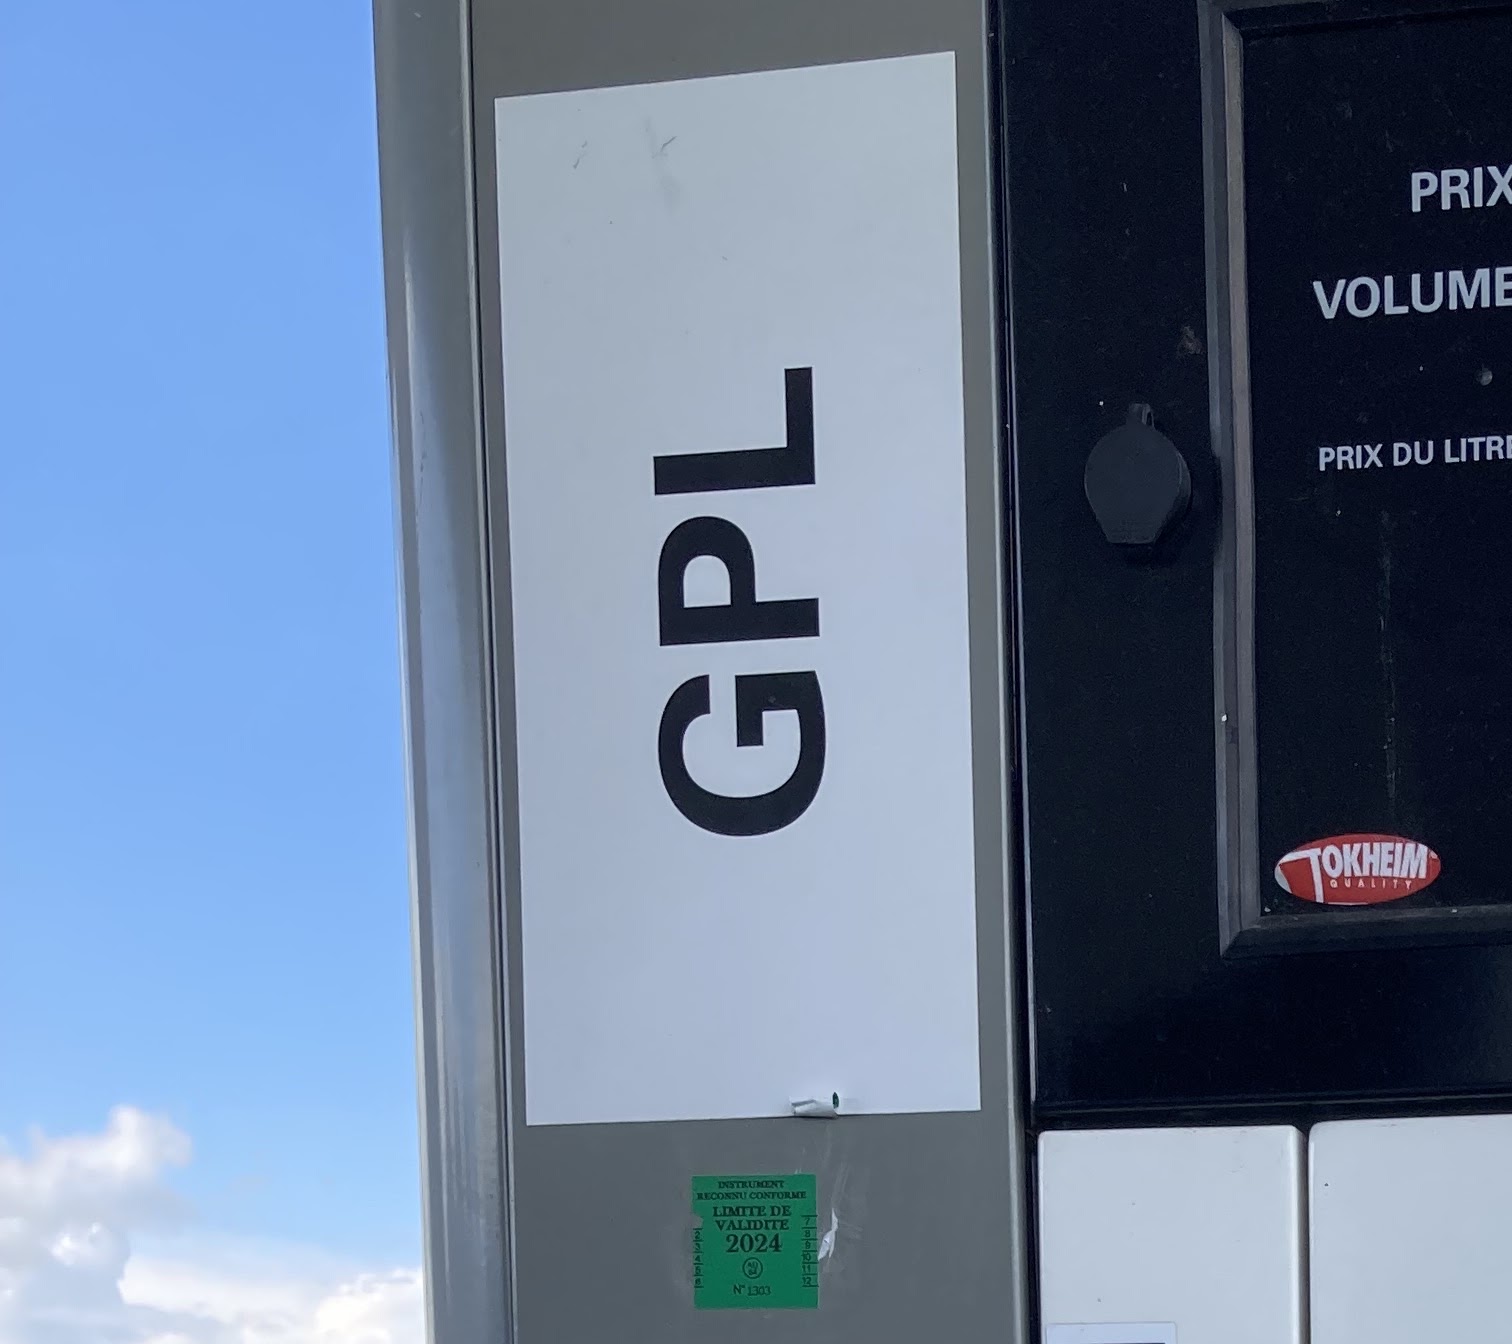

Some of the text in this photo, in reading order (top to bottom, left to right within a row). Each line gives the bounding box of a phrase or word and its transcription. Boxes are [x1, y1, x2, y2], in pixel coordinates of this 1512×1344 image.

[1318, 442, 1383, 472] PRIX
[1393, 439, 1436, 467] DU
[653, 367, 826, 836] GPL
[1279, 842, 1429, 903] TOKHEIM
[1330, 878, 1413, 889] QUALITY
[718, 1180, 784, 1189] INSTRUMENT
[697, 1191, 806, 1200] RECONNU CONFORME
[713, 1205, 792, 1217] LIMITE DE
[715, 1220, 789, 1231] VALIDITE
[726, 1233, 782, 1253] 2024
